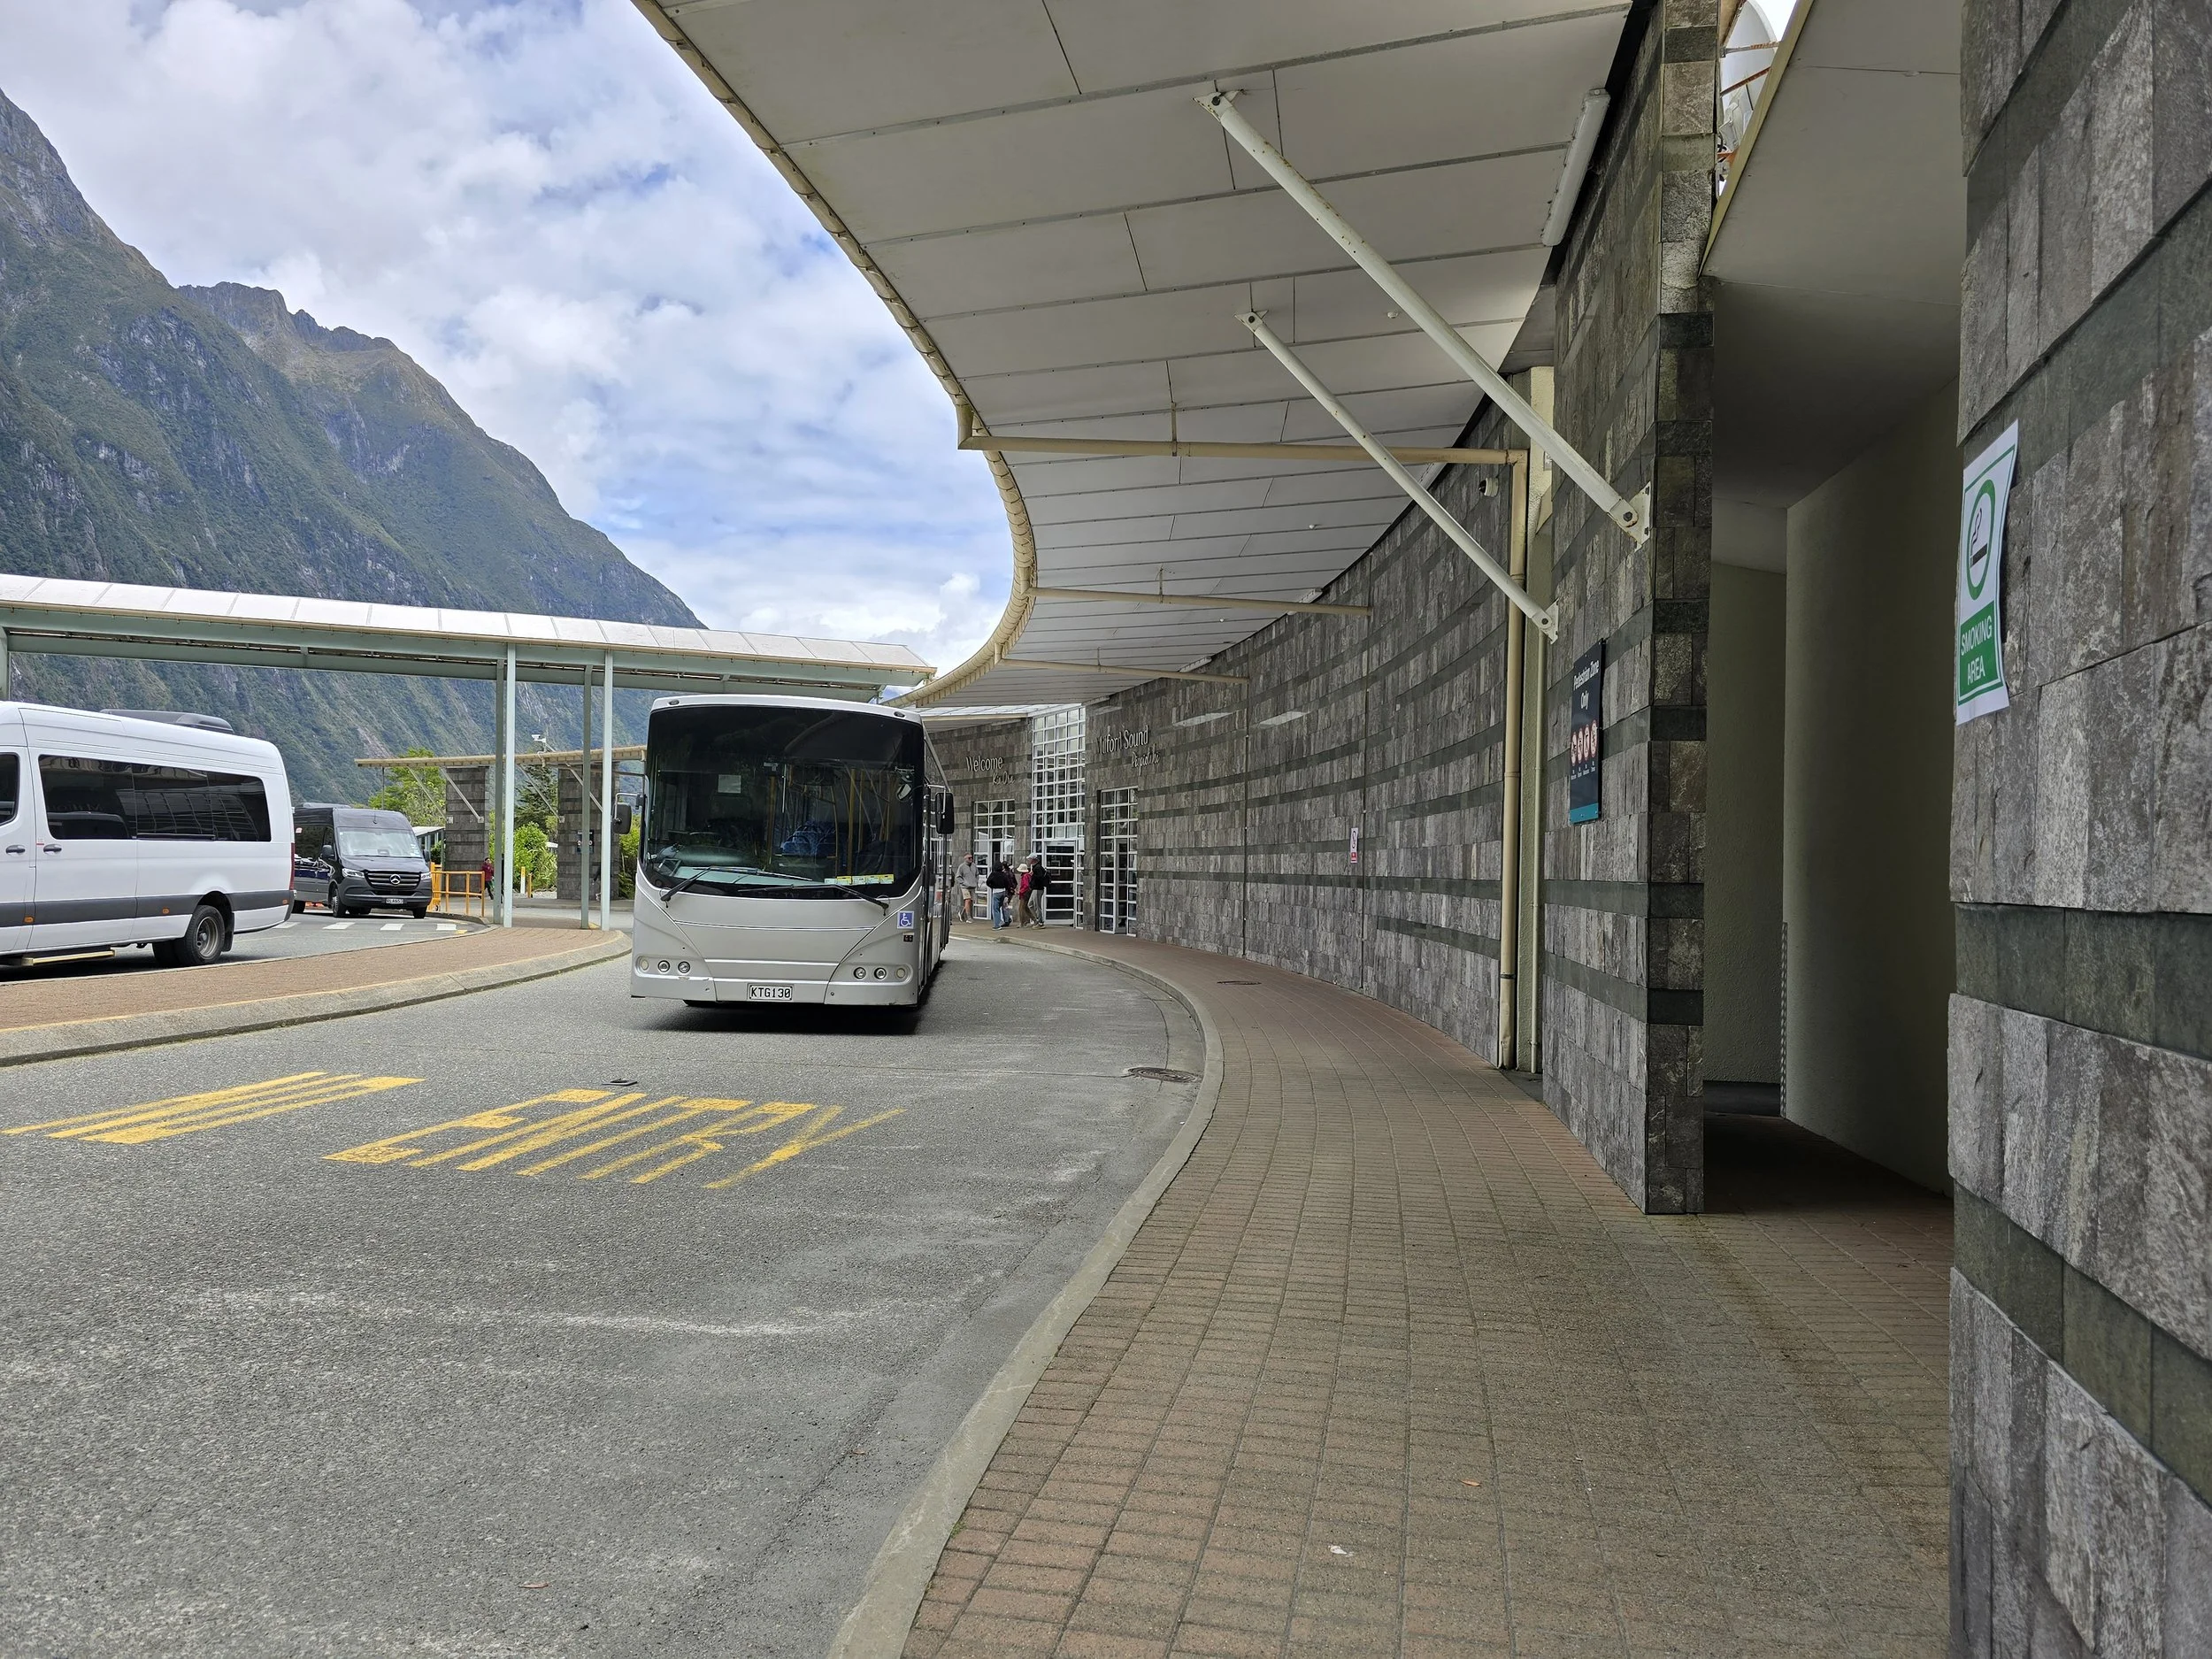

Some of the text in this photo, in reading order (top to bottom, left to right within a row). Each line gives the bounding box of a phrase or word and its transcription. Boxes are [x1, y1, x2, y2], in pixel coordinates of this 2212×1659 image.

[1961, 615, 1992, 656] SMOKING
[1590, 659, 1600, 679] Zone
[1967, 655, 1985, 686] AREA
[1580, 690, 1589, 710] Only
[1123, 725, 1148, 749] Sound
[965, 756, 1004, 772] Welcome
[751, 987, 791, 998] KTG130
[321, 1087, 909, 1189] ENTRY
